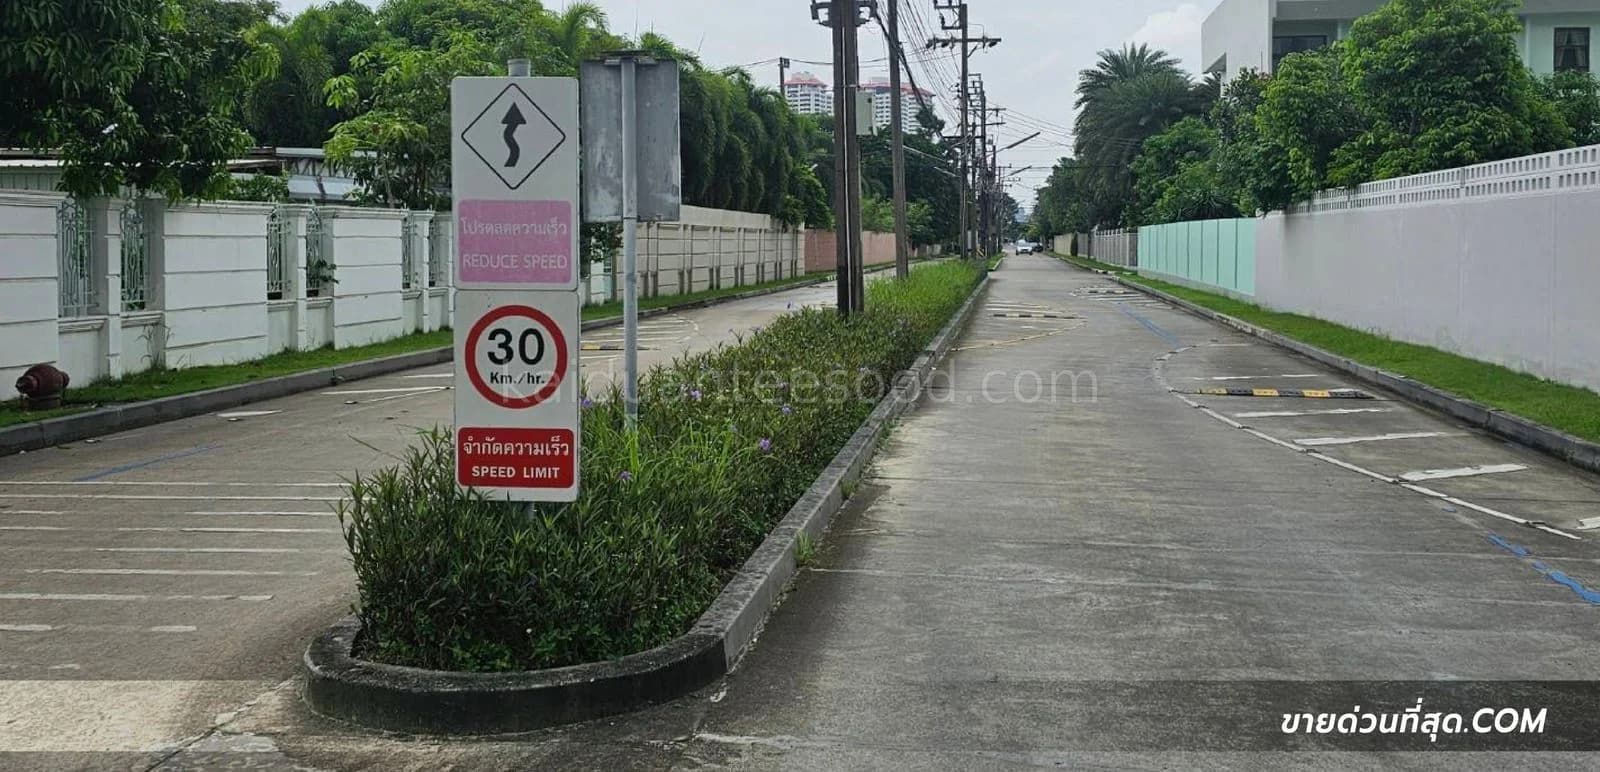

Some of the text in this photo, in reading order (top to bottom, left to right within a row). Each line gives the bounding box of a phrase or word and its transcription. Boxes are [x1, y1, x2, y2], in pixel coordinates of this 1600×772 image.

[462, 254, 568, 269] REDUCE SPEED
[487, 327, 545, 366] 30
[489, 371, 546, 385] Km./hr.
[462, 434, 570, 457] จำกัดความเร็ว
[471, 466, 561, 480] SPEED LIMIT
